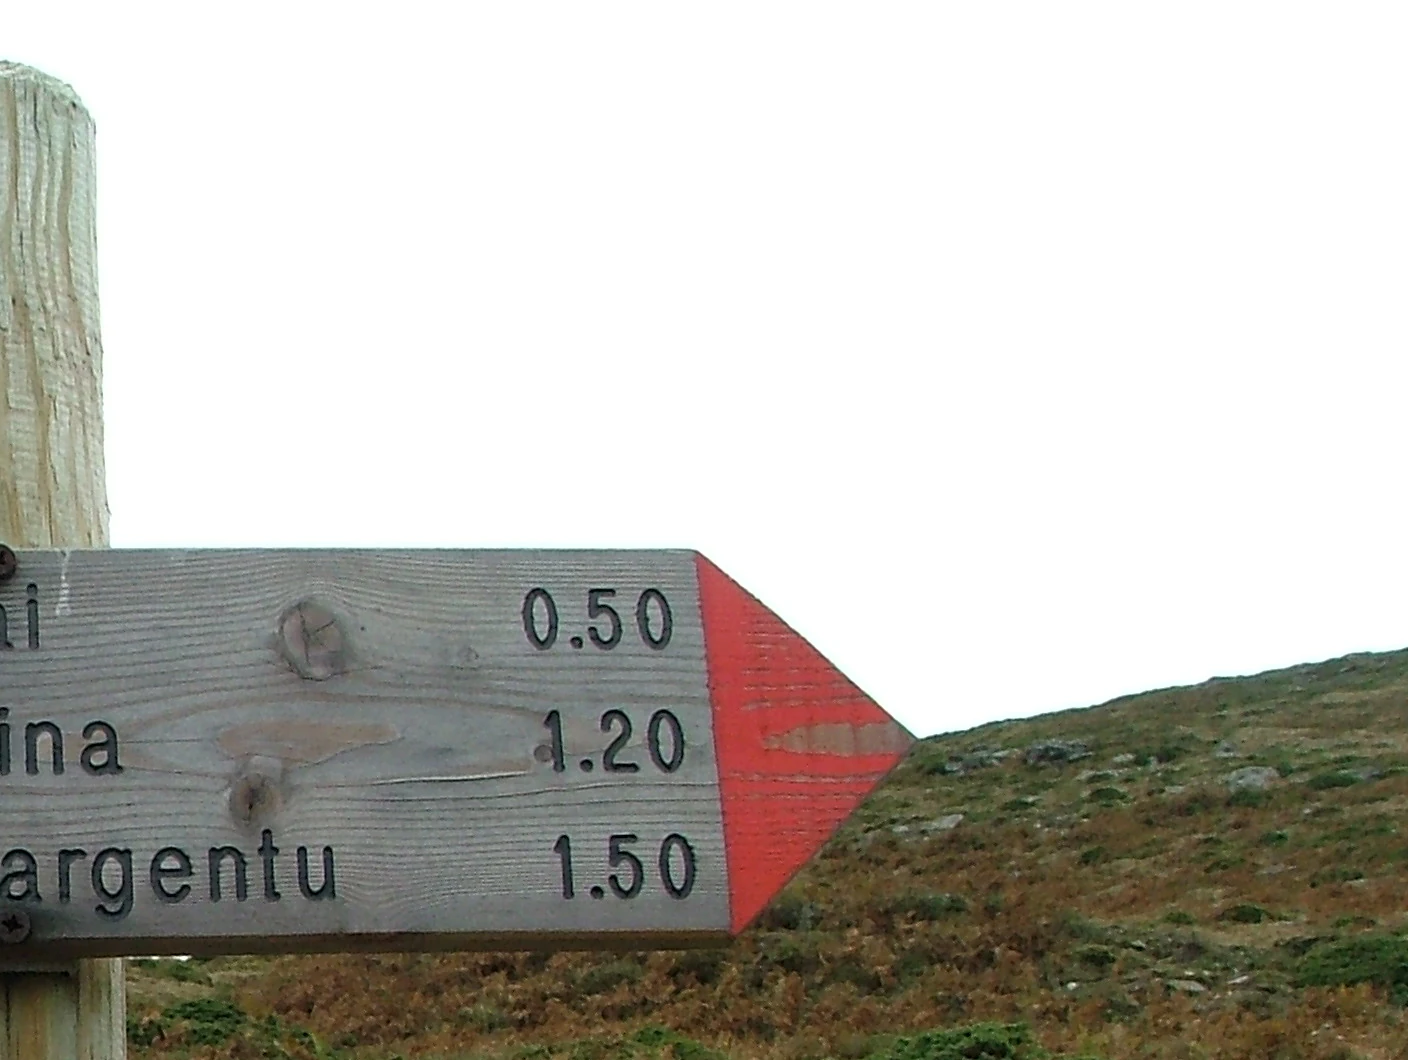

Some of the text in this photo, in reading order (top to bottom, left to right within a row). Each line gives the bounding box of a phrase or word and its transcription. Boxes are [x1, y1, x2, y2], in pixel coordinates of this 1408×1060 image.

[522, 588, 673, 650] 0.50
[543, 708, 685, 773] 1.20
[554, 834, 696, 900] 1.50
